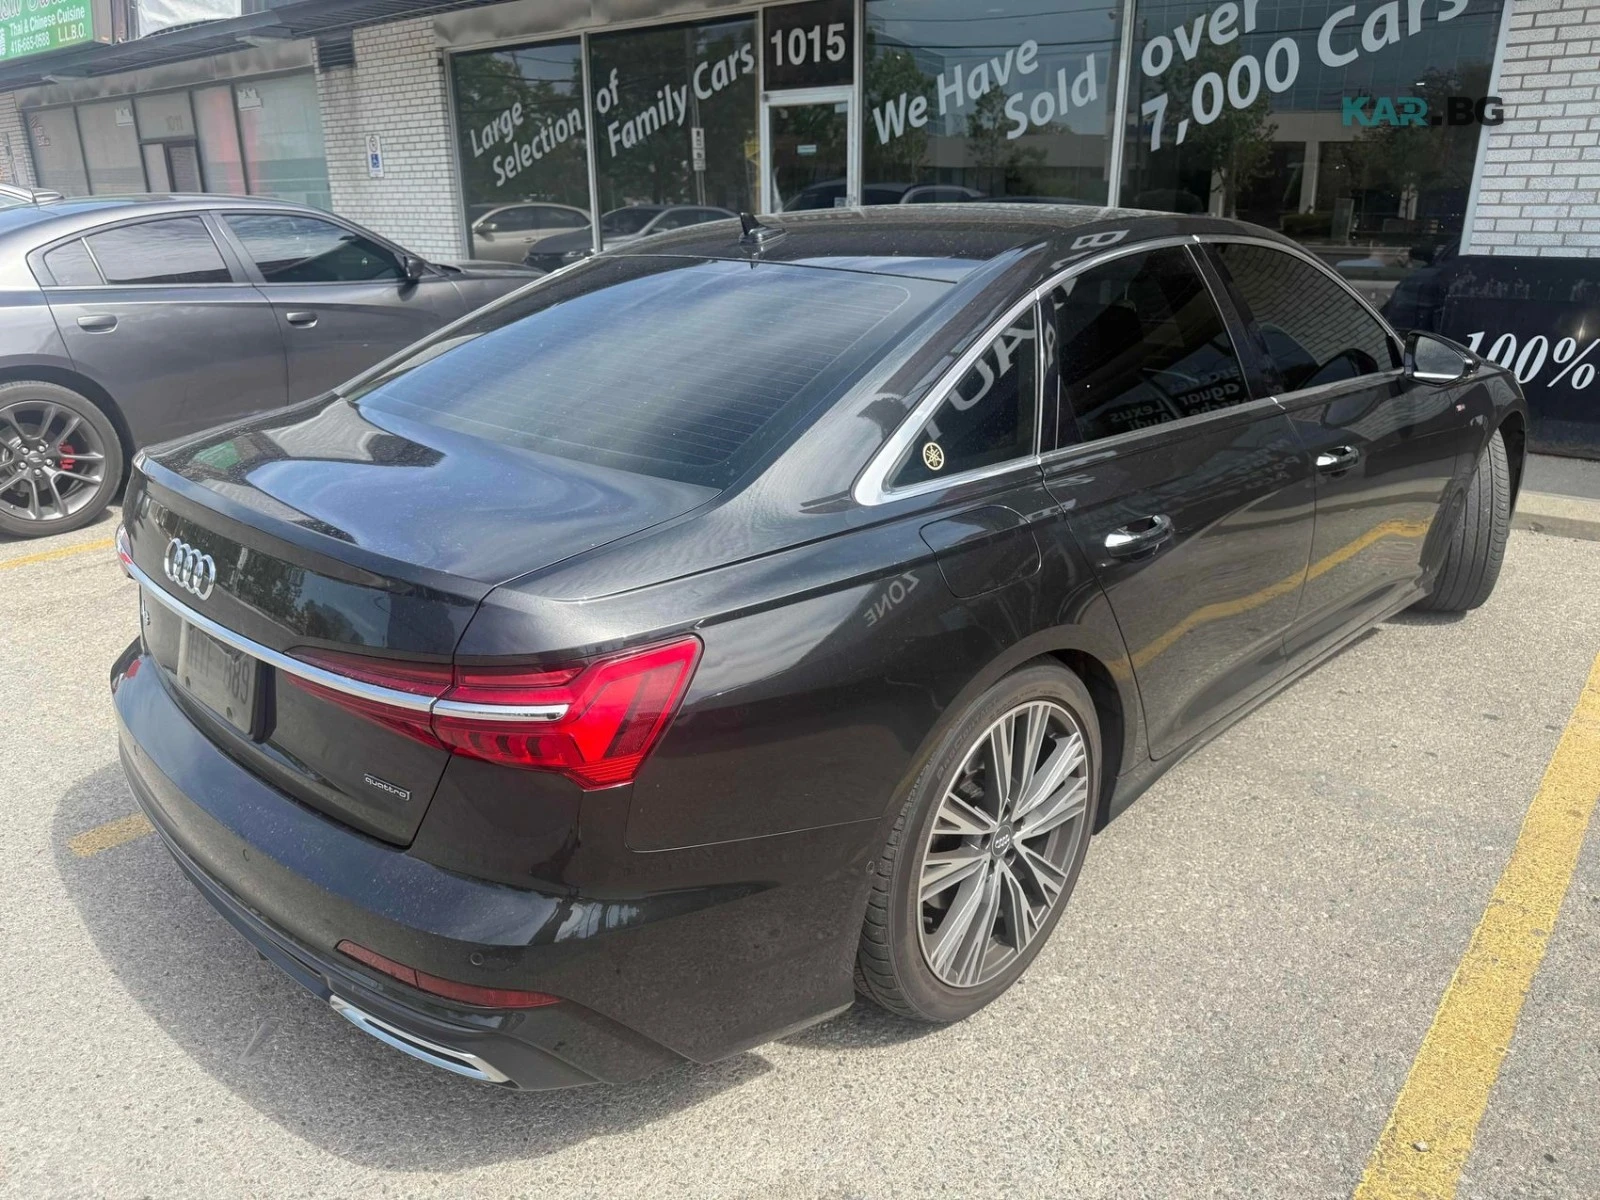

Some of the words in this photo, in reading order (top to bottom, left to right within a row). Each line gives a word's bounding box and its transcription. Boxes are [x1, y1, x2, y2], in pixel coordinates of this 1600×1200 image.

[9, 20, 24, 37] Thai
[24, 18, 30, 34] &
[30, 13, 57, 32] Chinese
[57, 5, 86, 24] Cuisine
[770, 23, 846, 66] 1015
[1141, 0, 1260, 77] over
[470, 102, 524, 158] Large
[493, 107, 583, 187] Selection
[596, 67, 618, 114] of
[607, 84, 688, 158] Family
[693, 42, 755, 100] Cars
[872, 92, 928, 145] We
[937, 39, 1039, 116] Have
[1004, 52, 1098, 140] Sold
[1141, 37, 1300, 152] 7,000
[364, 776, 407, 798] quattro
